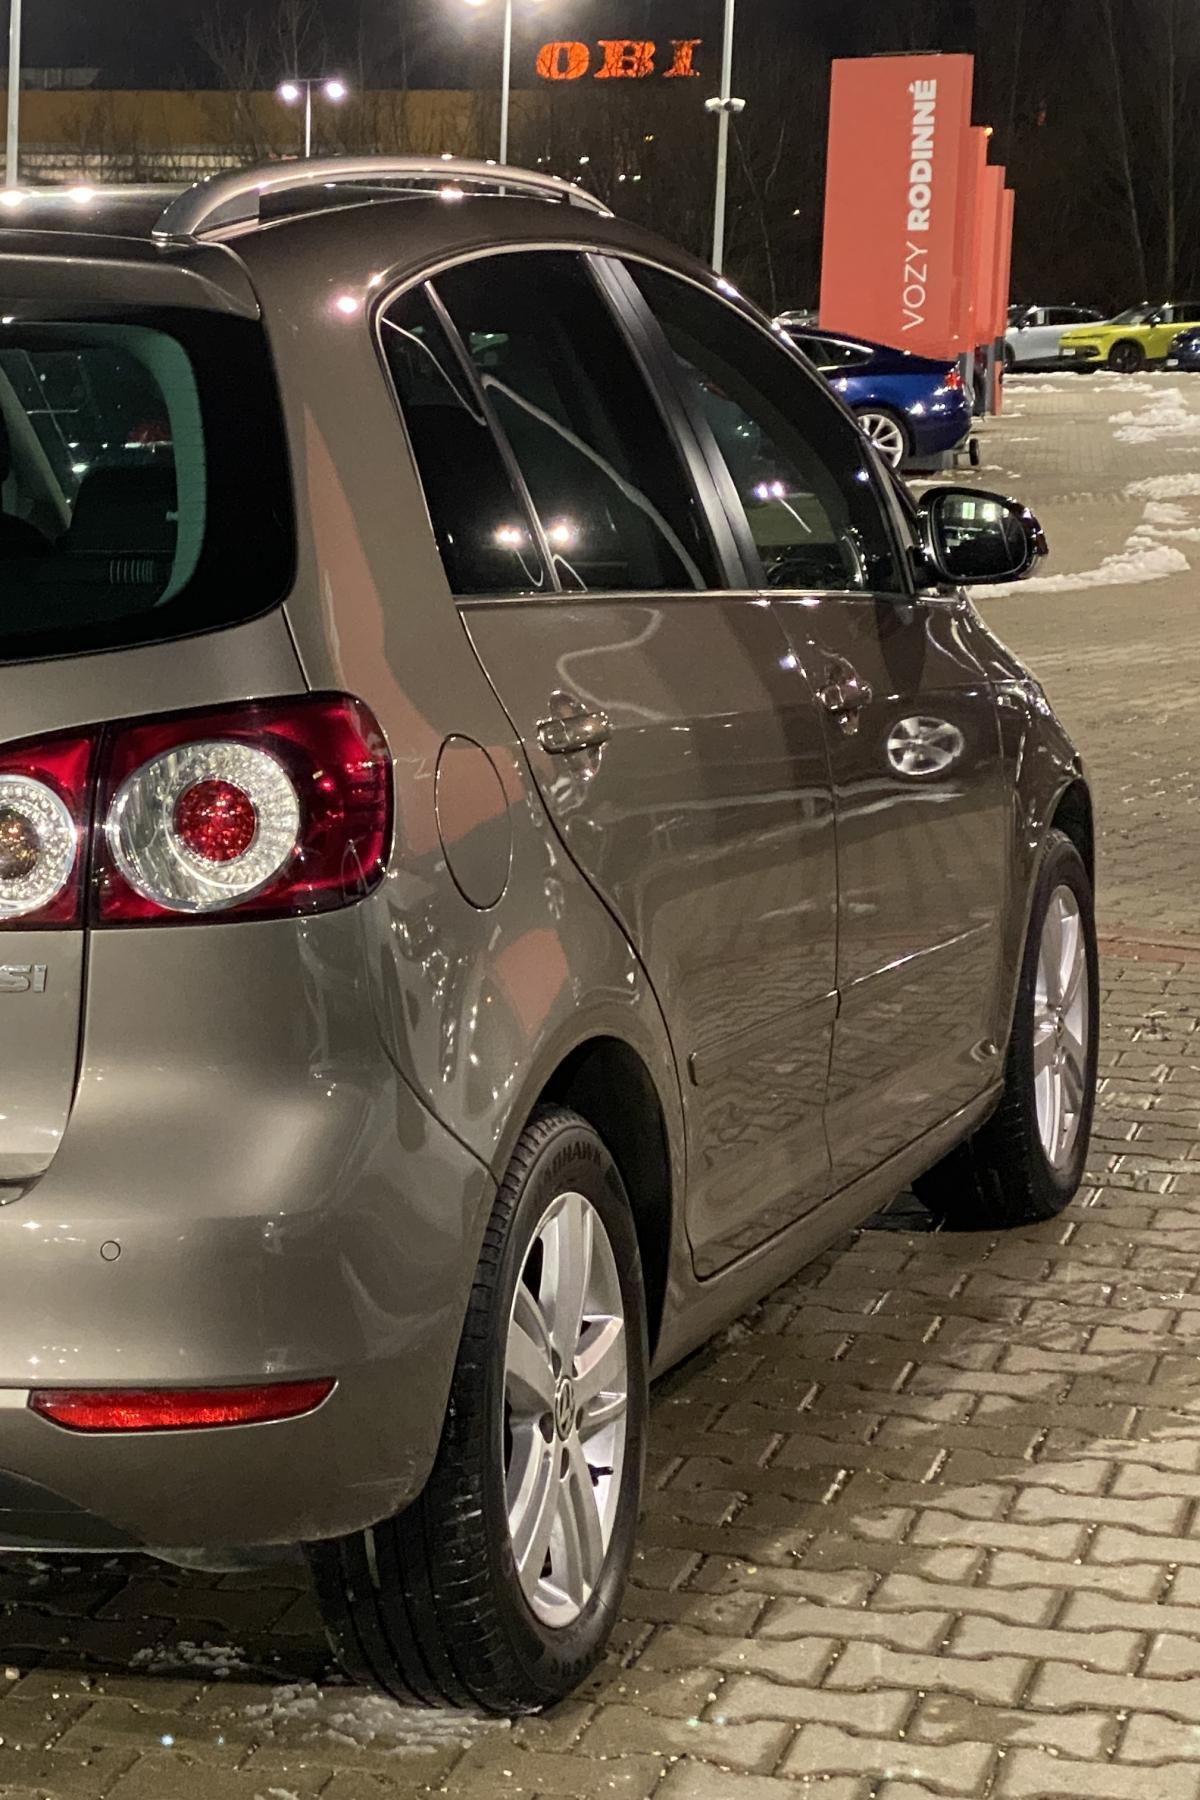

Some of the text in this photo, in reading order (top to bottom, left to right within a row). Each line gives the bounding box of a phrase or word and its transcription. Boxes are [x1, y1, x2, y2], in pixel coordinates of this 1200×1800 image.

[535, 38, 702, 80] OBI
[902, 79, 937, 331] VOZY RODINNÉ
